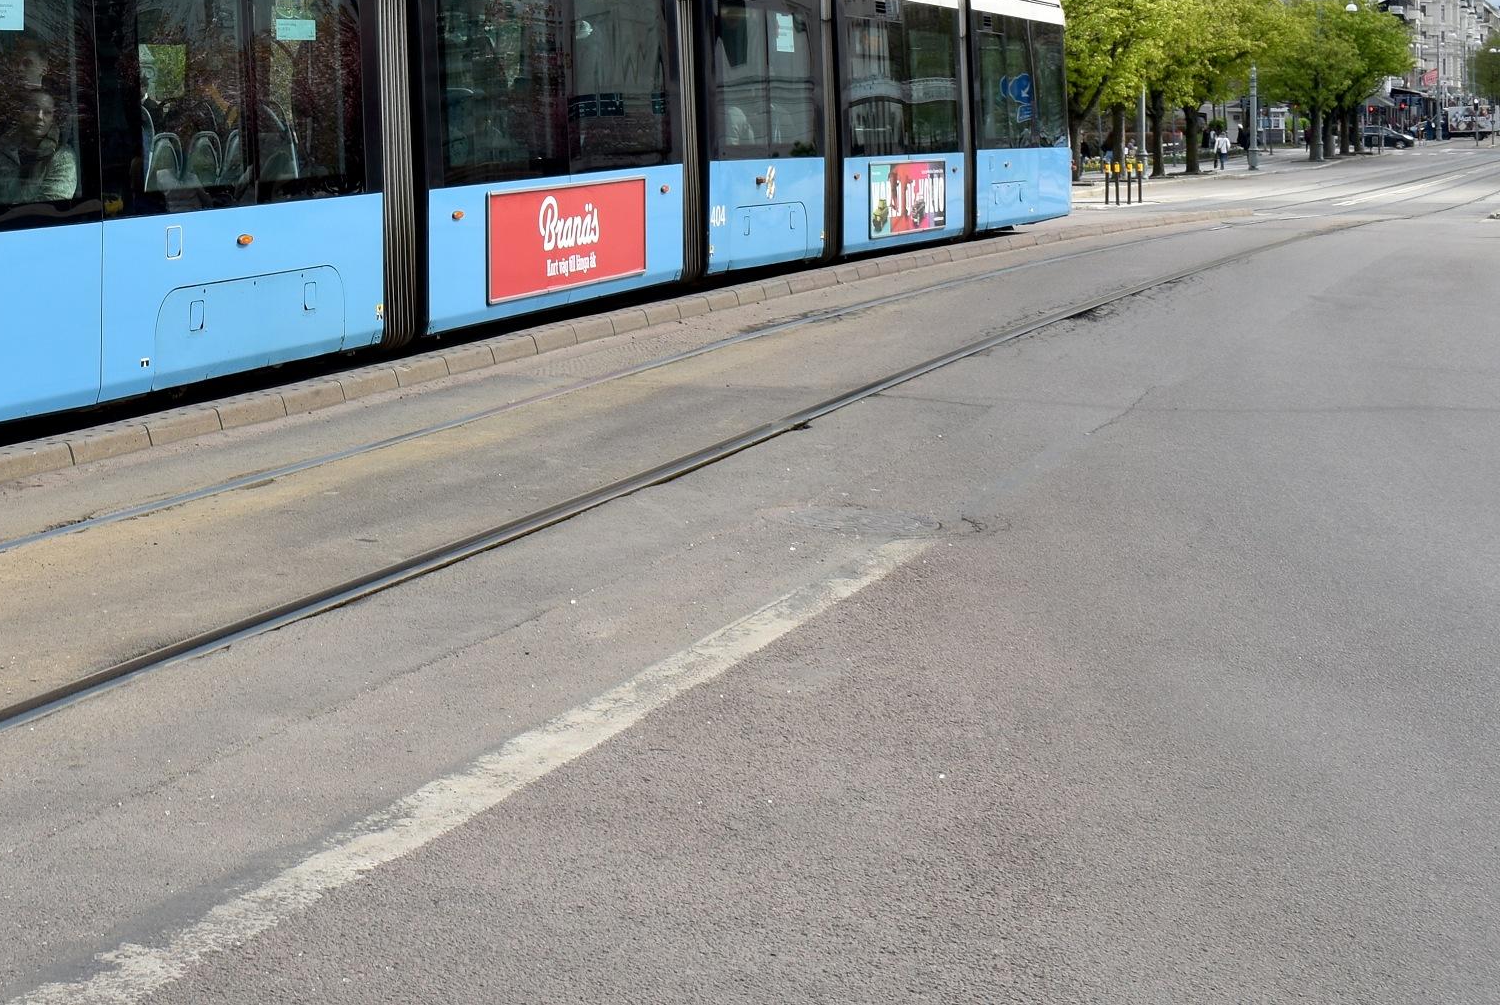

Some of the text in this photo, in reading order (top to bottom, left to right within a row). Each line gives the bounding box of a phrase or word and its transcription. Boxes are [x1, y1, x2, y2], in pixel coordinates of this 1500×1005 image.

[918, 177, 945, 214] VOLVO
[538, 195, 600, 251] Branäs
[710, 205, 726, 227] 404
